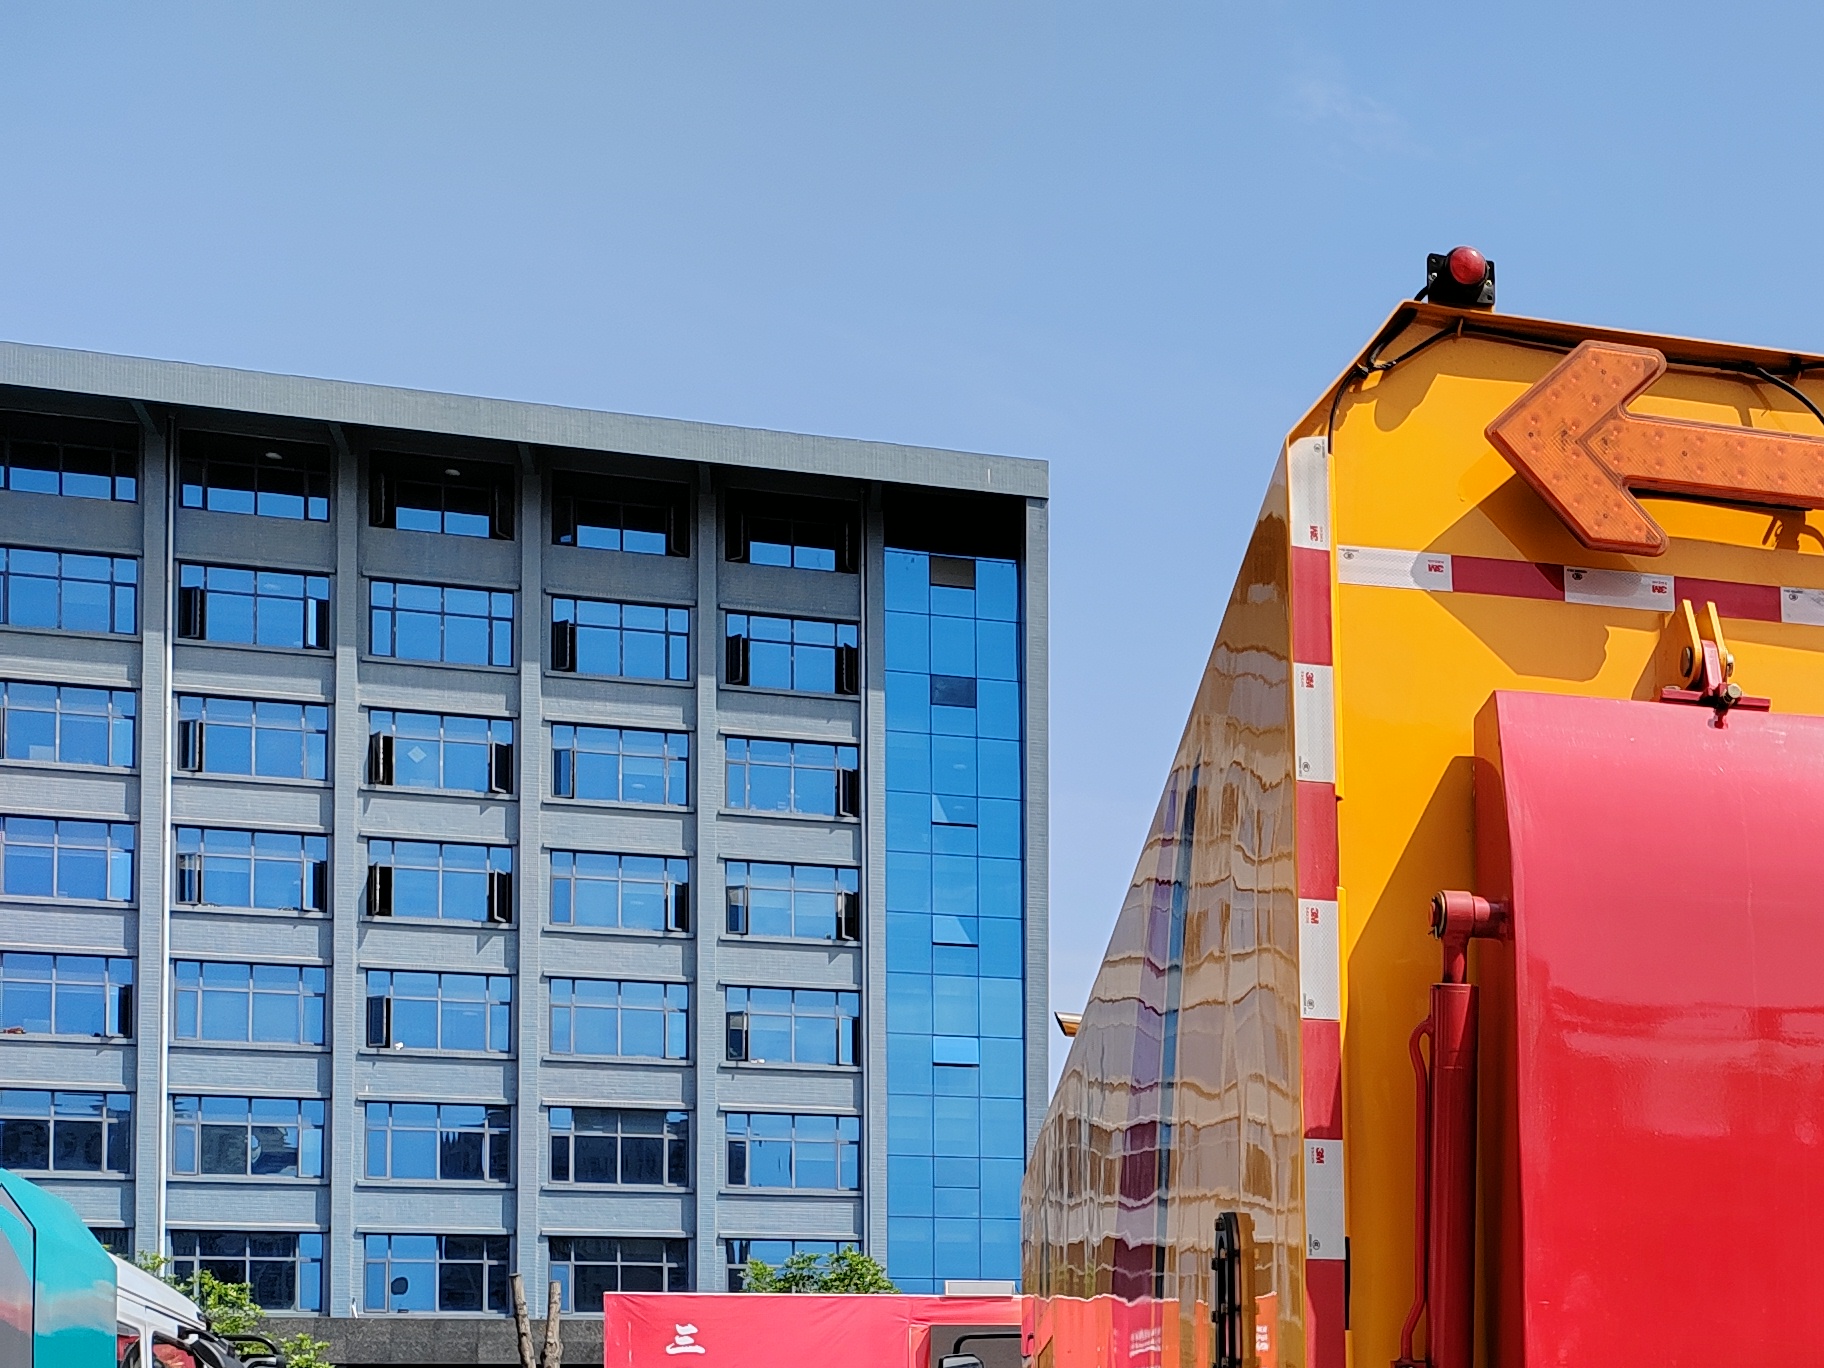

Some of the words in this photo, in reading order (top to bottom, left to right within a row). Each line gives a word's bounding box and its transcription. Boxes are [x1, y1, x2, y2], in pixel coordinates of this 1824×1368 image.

[1427, 563, 1443, 573] 3M
[1651, 584, 1667, 595] 3M
[1305, 671, 1314, 690] 3M
[1309, 907, 1320, 926] 3M
[1315, 1147, 1325, 1166] 3M
